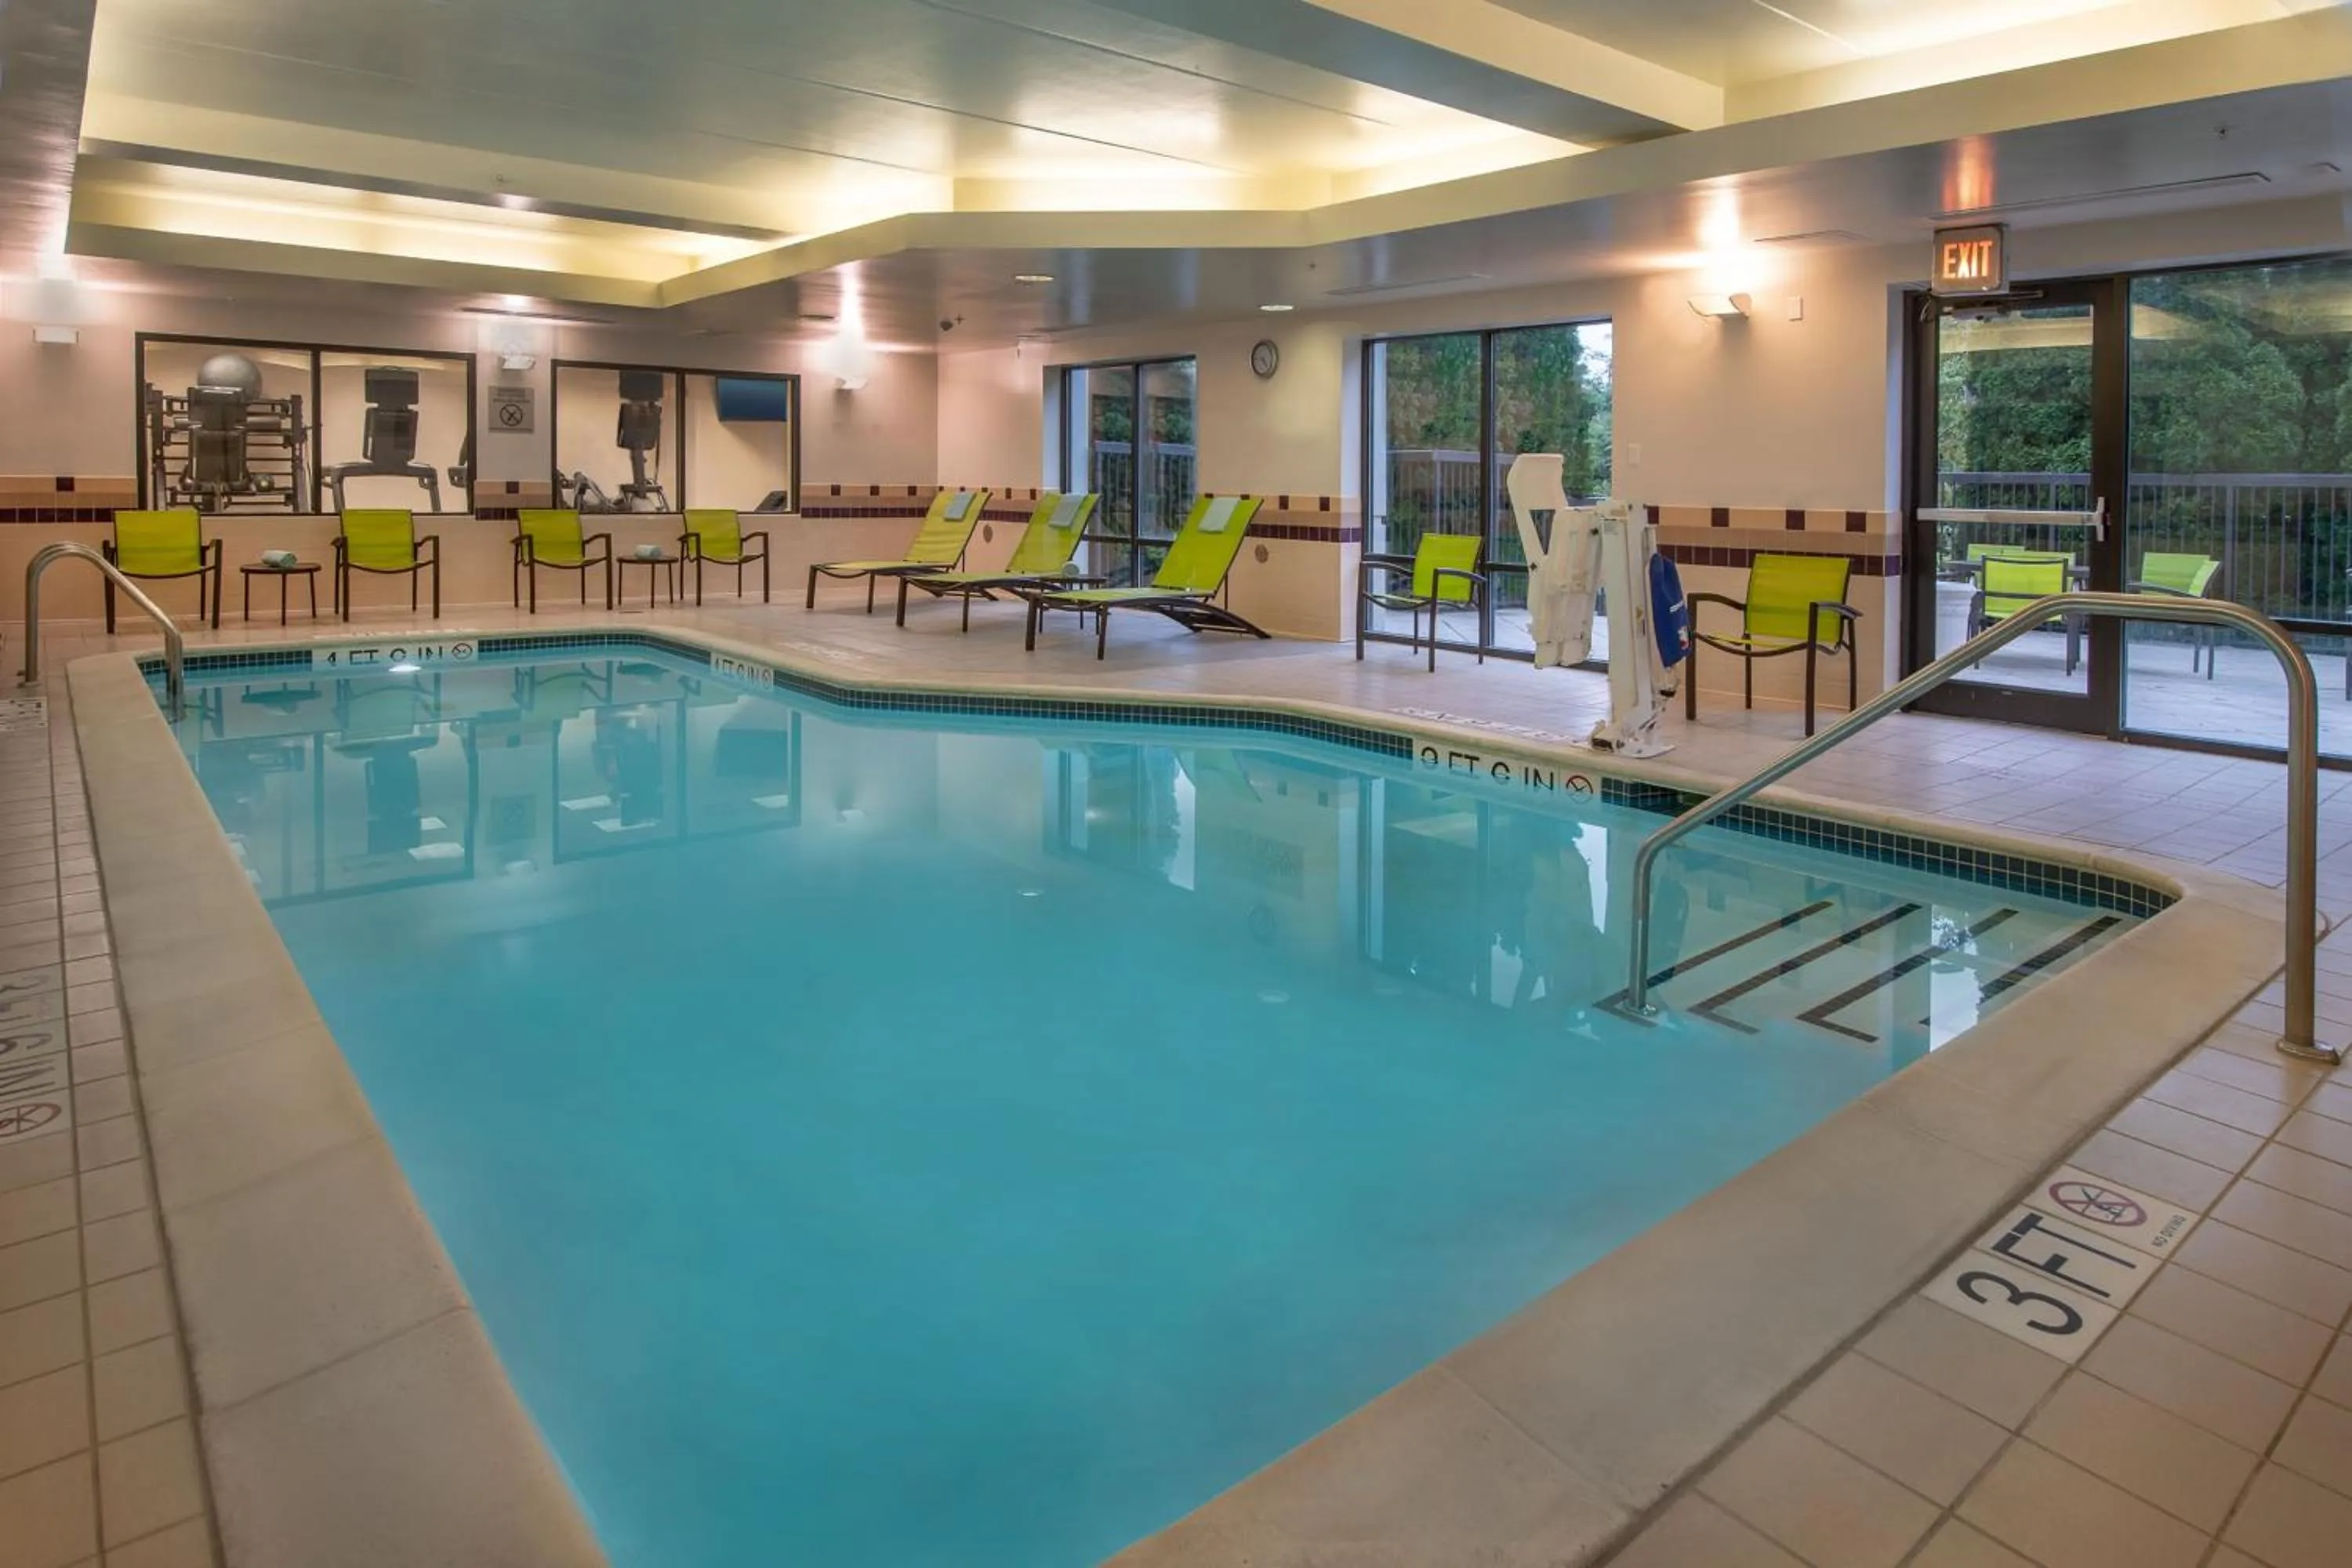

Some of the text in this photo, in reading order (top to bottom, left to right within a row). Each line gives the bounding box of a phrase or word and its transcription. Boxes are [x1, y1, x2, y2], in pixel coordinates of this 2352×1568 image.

[1943, 240, 1993, 279] EXIT
[1957, 1212, 2136, 1335] 3 FT
